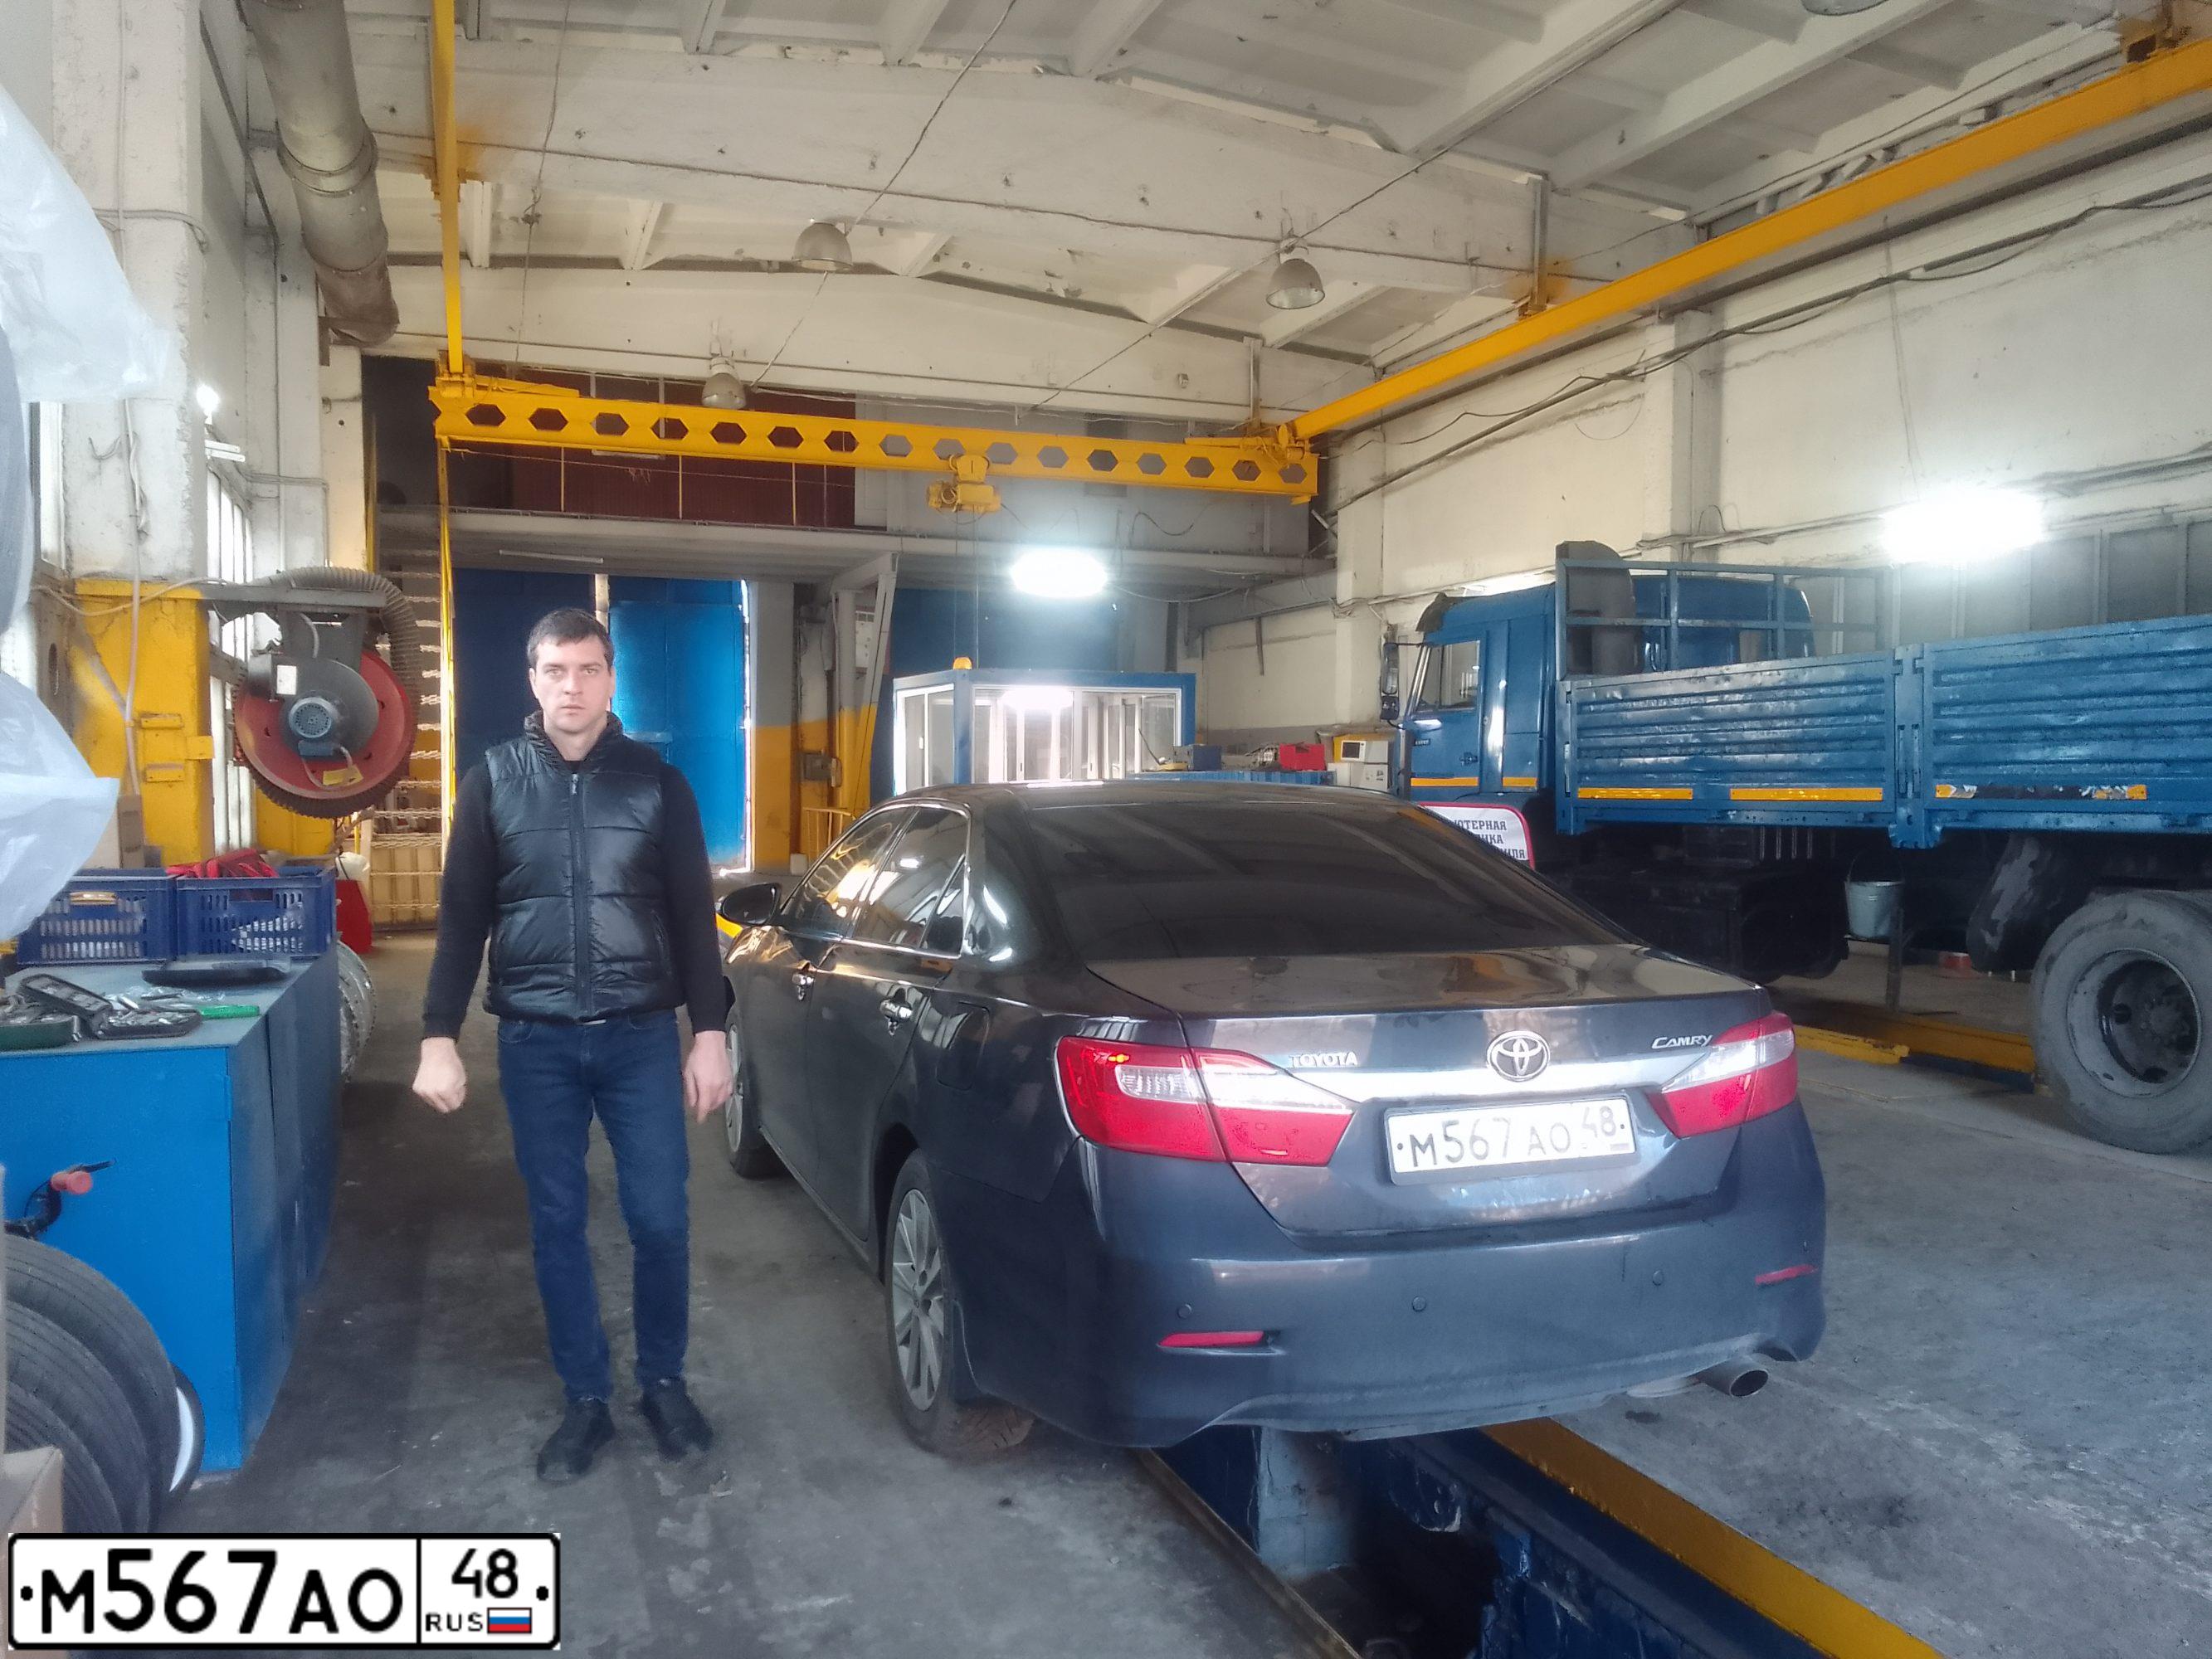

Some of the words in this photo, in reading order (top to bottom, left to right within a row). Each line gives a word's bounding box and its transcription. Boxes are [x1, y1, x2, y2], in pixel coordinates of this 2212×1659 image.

[1651, 1034, 1713, 1049] CAMRY
[1289, 1051, 1358, 1068] TOYOTA
[1581, 1105, 1617, 1138] 48
